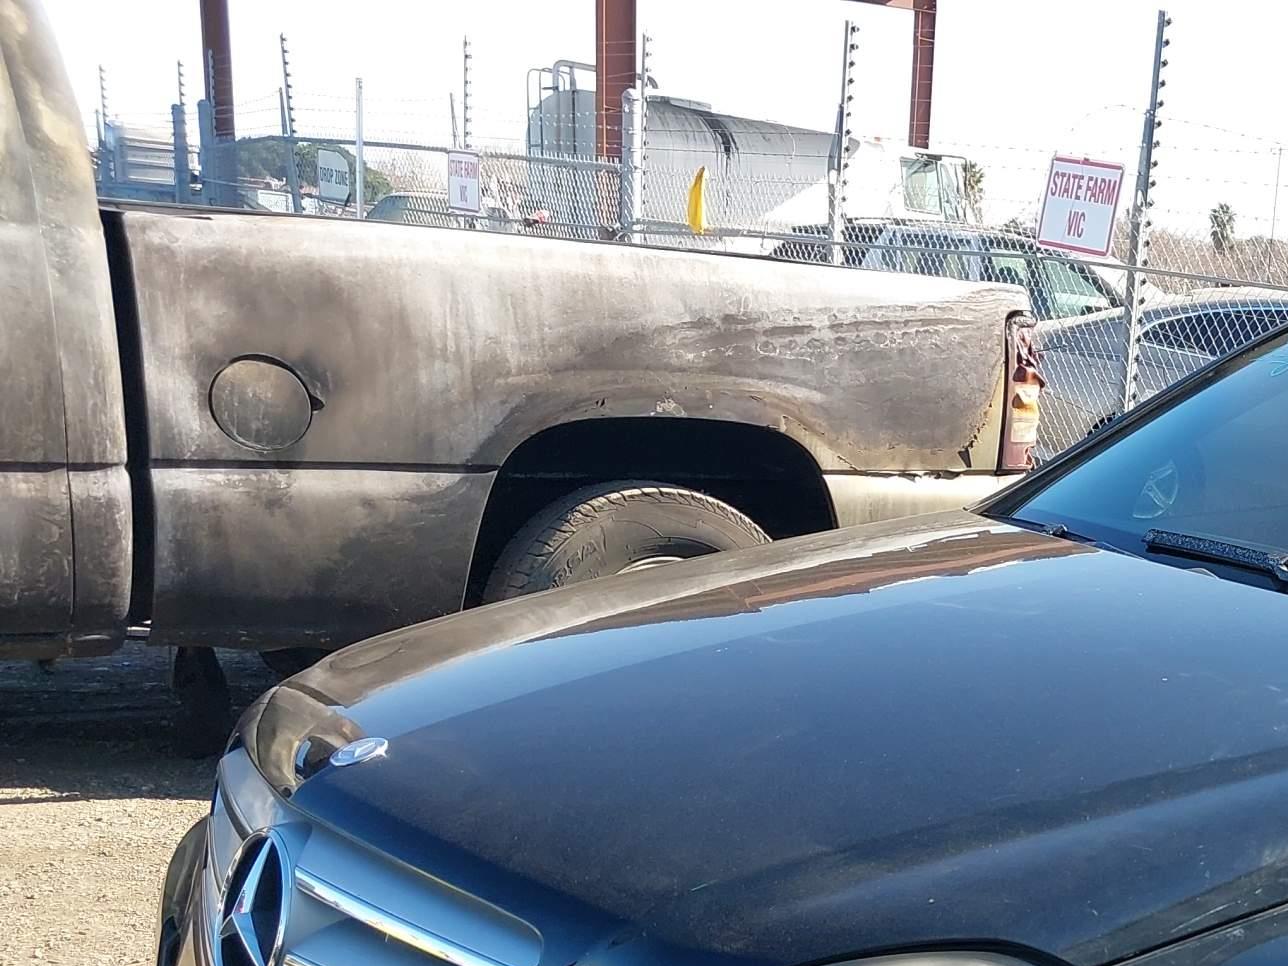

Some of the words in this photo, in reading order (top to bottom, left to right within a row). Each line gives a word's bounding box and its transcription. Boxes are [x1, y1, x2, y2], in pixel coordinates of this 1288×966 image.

[319, 166, 334, 184] DROP
[335, 168, 349, 187] ZONE
[1050, 170, 1085, 201] STATE
[1083, 175, 1118, 206] FARM
[1067, 209, 1086, 239] VIC
